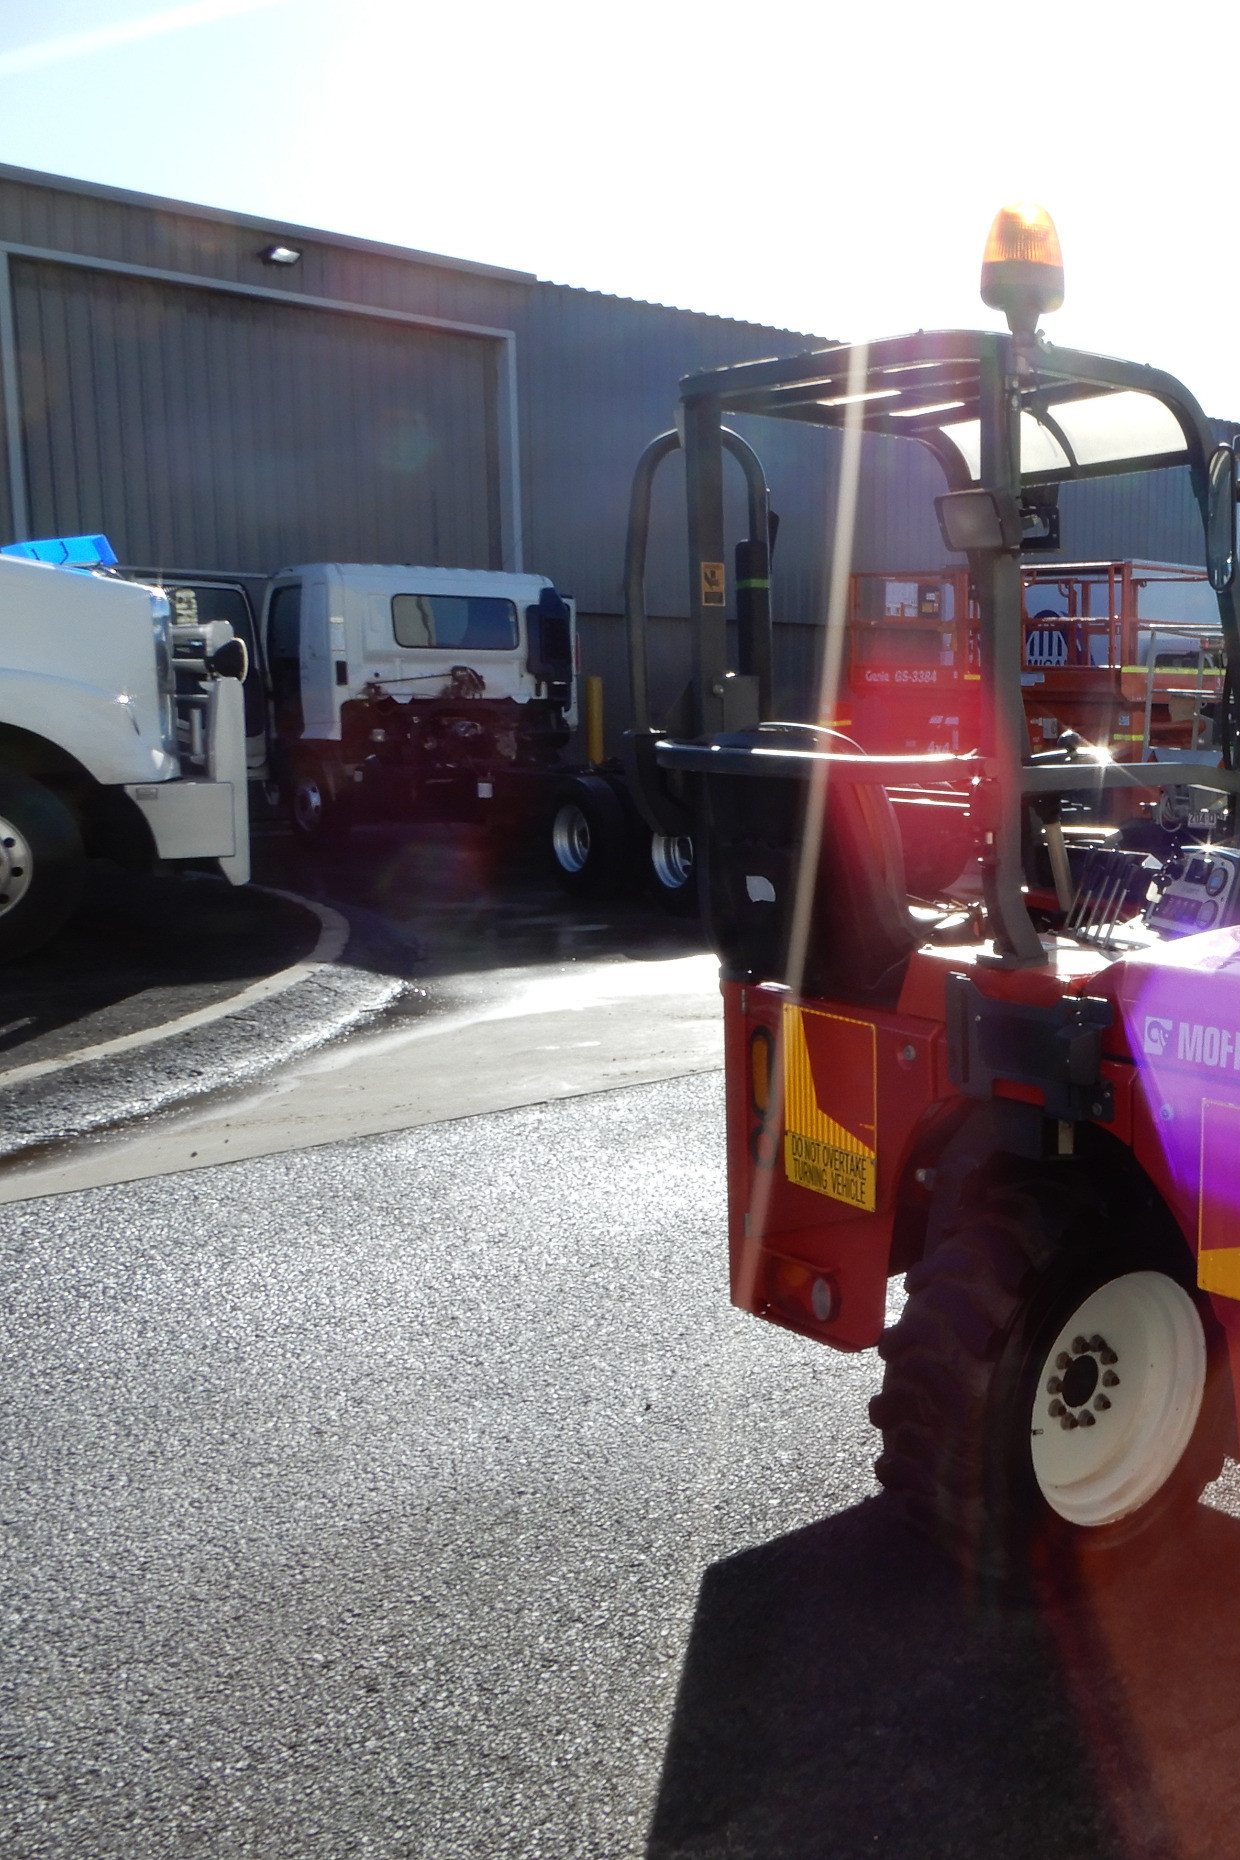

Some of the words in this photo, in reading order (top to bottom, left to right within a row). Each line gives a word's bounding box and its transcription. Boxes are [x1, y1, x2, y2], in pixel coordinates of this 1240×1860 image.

[791, 1134, 803, 1158] DO
[804, 1141, 821, 1164] NOT
[822, 1145, 866, 1181] OVERTAKE
[793, 1157, 828, 1190] TURNING
[830, 1171, 866, 1205] VEHICLE
